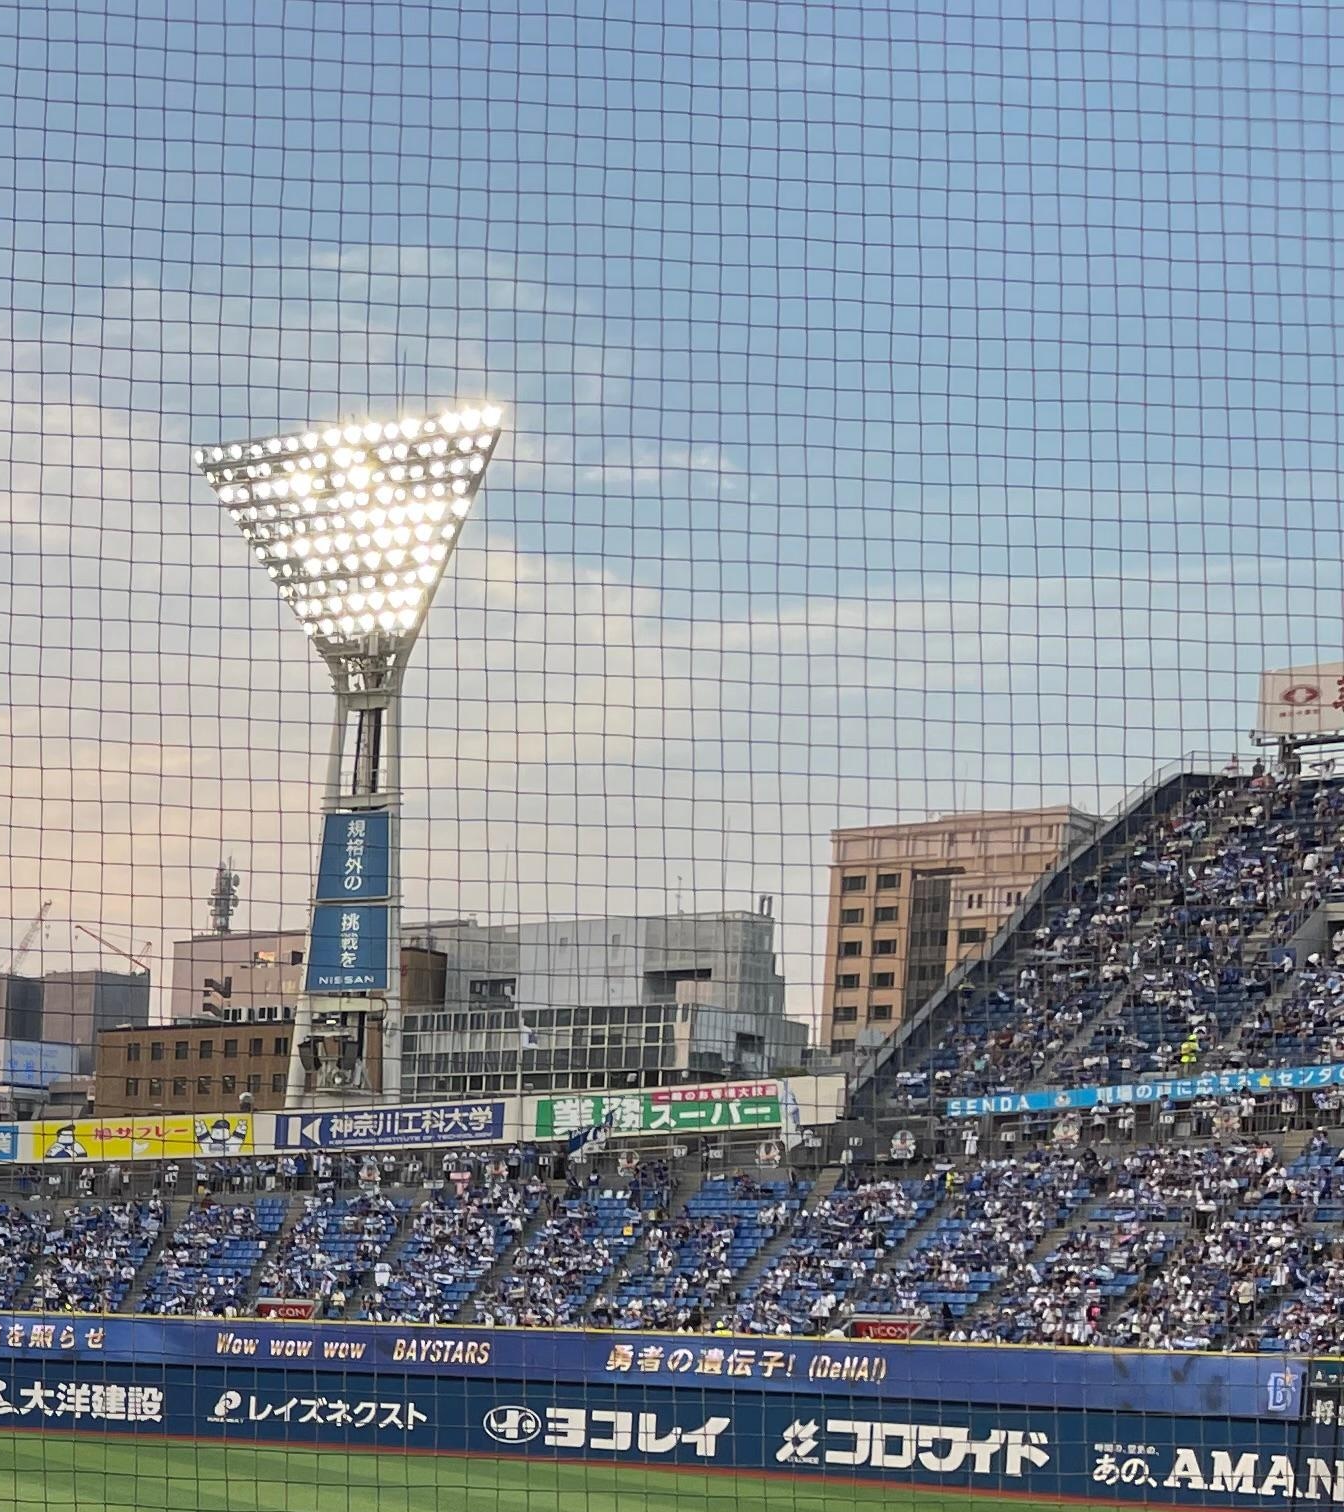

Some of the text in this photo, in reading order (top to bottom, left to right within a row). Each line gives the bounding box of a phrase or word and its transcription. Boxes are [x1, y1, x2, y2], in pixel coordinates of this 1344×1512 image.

[344, 819, 366, 891] 規格外の
[340, 912, 361, 968] 挑戦を
[318, 975, 374, 985] NISSAN
[329, 1105, 493, 1138] 神奈川工科大学
[949, 1094, 1031, 1116] SENDA
[216, 1332, 491, 1365] Wow wow wow BAYSTARS
[19, 1380, 164, 1423] 大洋建設
[249, 1395, 428, 1431] レイズネクスト
[544, 1406, 731, 1457] ヨコレイ
[825, 1419, 1051, 1478] コロワイド
